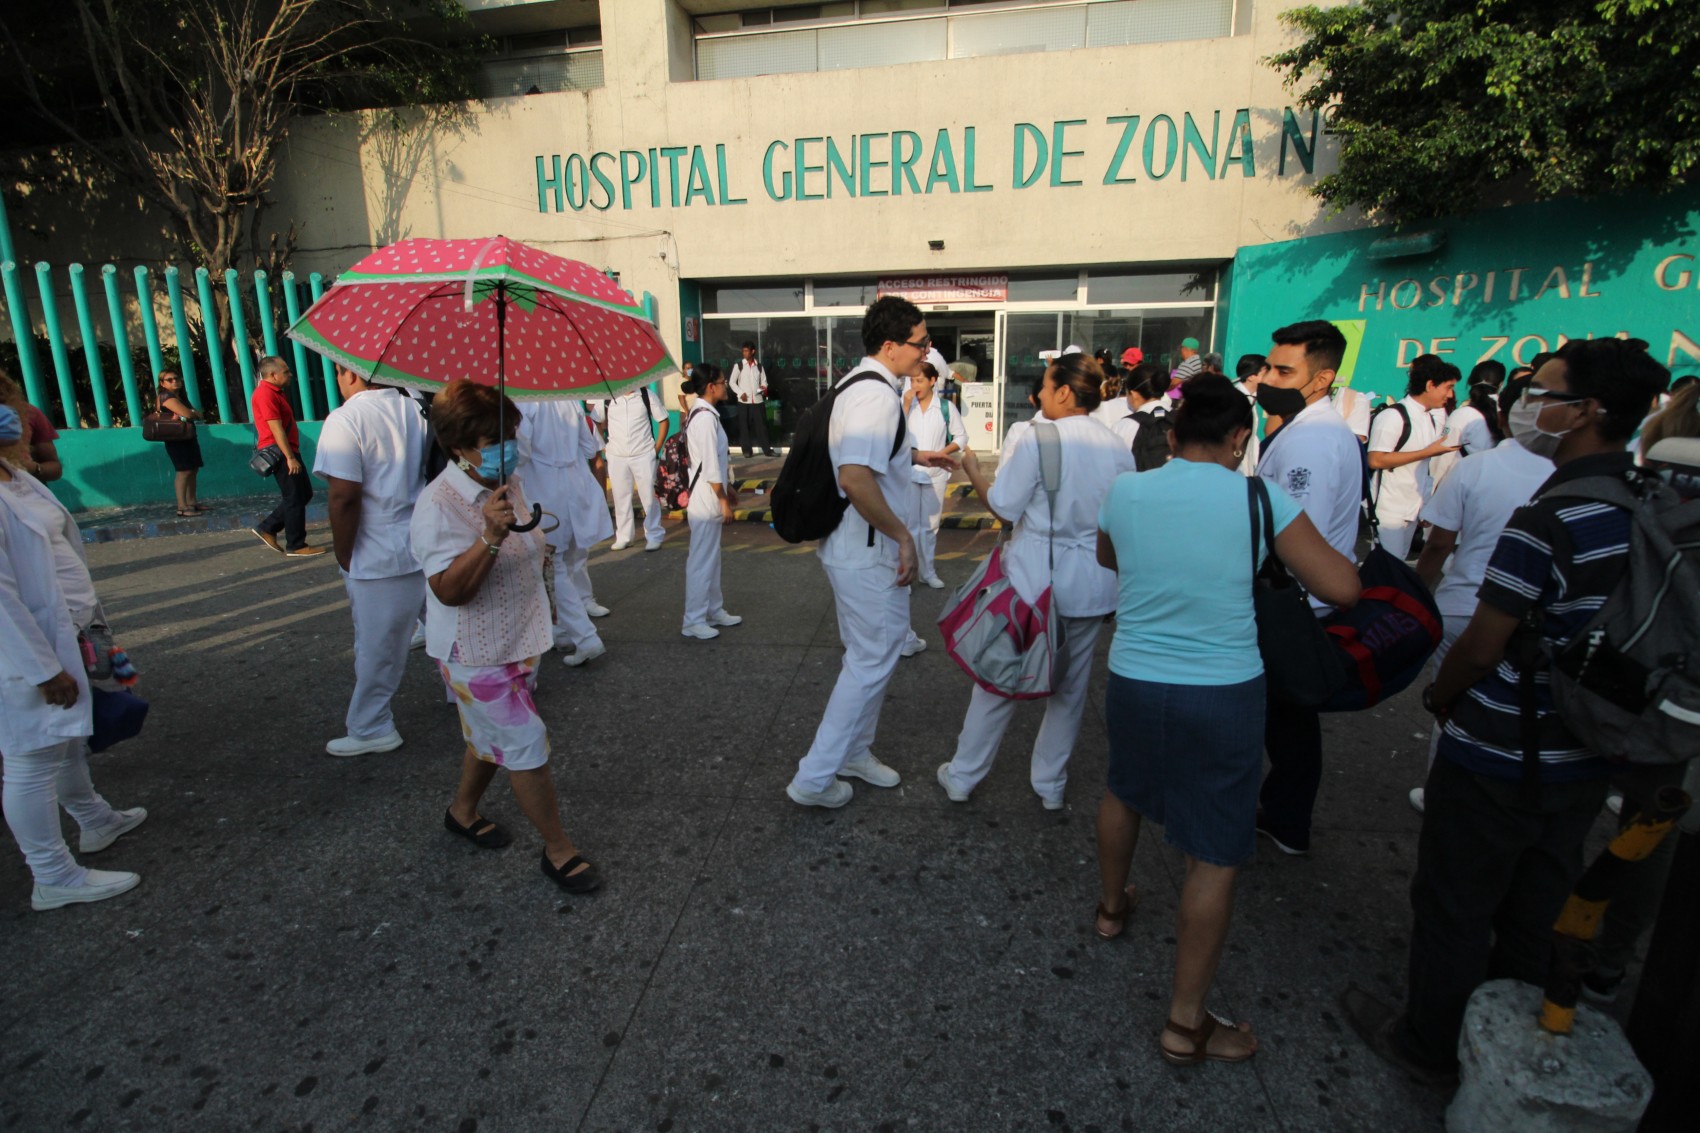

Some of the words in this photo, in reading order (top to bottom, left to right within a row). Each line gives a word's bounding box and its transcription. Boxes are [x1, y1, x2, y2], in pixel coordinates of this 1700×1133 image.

[535, 143, 748, 213] HOSPITAL
[762, 126, 994, 202] GENERAL
[1012, 118, 1088, 189] DE
[1102, 107, 1256, 185] ZONA
[877, 279, 924, 290] ACCESO
[927, 275, 1009, 288] RESTRINGIDO
[911, 288, 1002, 300] CONTINGENCIA
[1357, 262, 1601, 313] HOSPITAL
[1654, 253, 1700, 291] G
[1475, 331, 1630, 367] ZO
[970, 401, 993, 409] PUERTA
